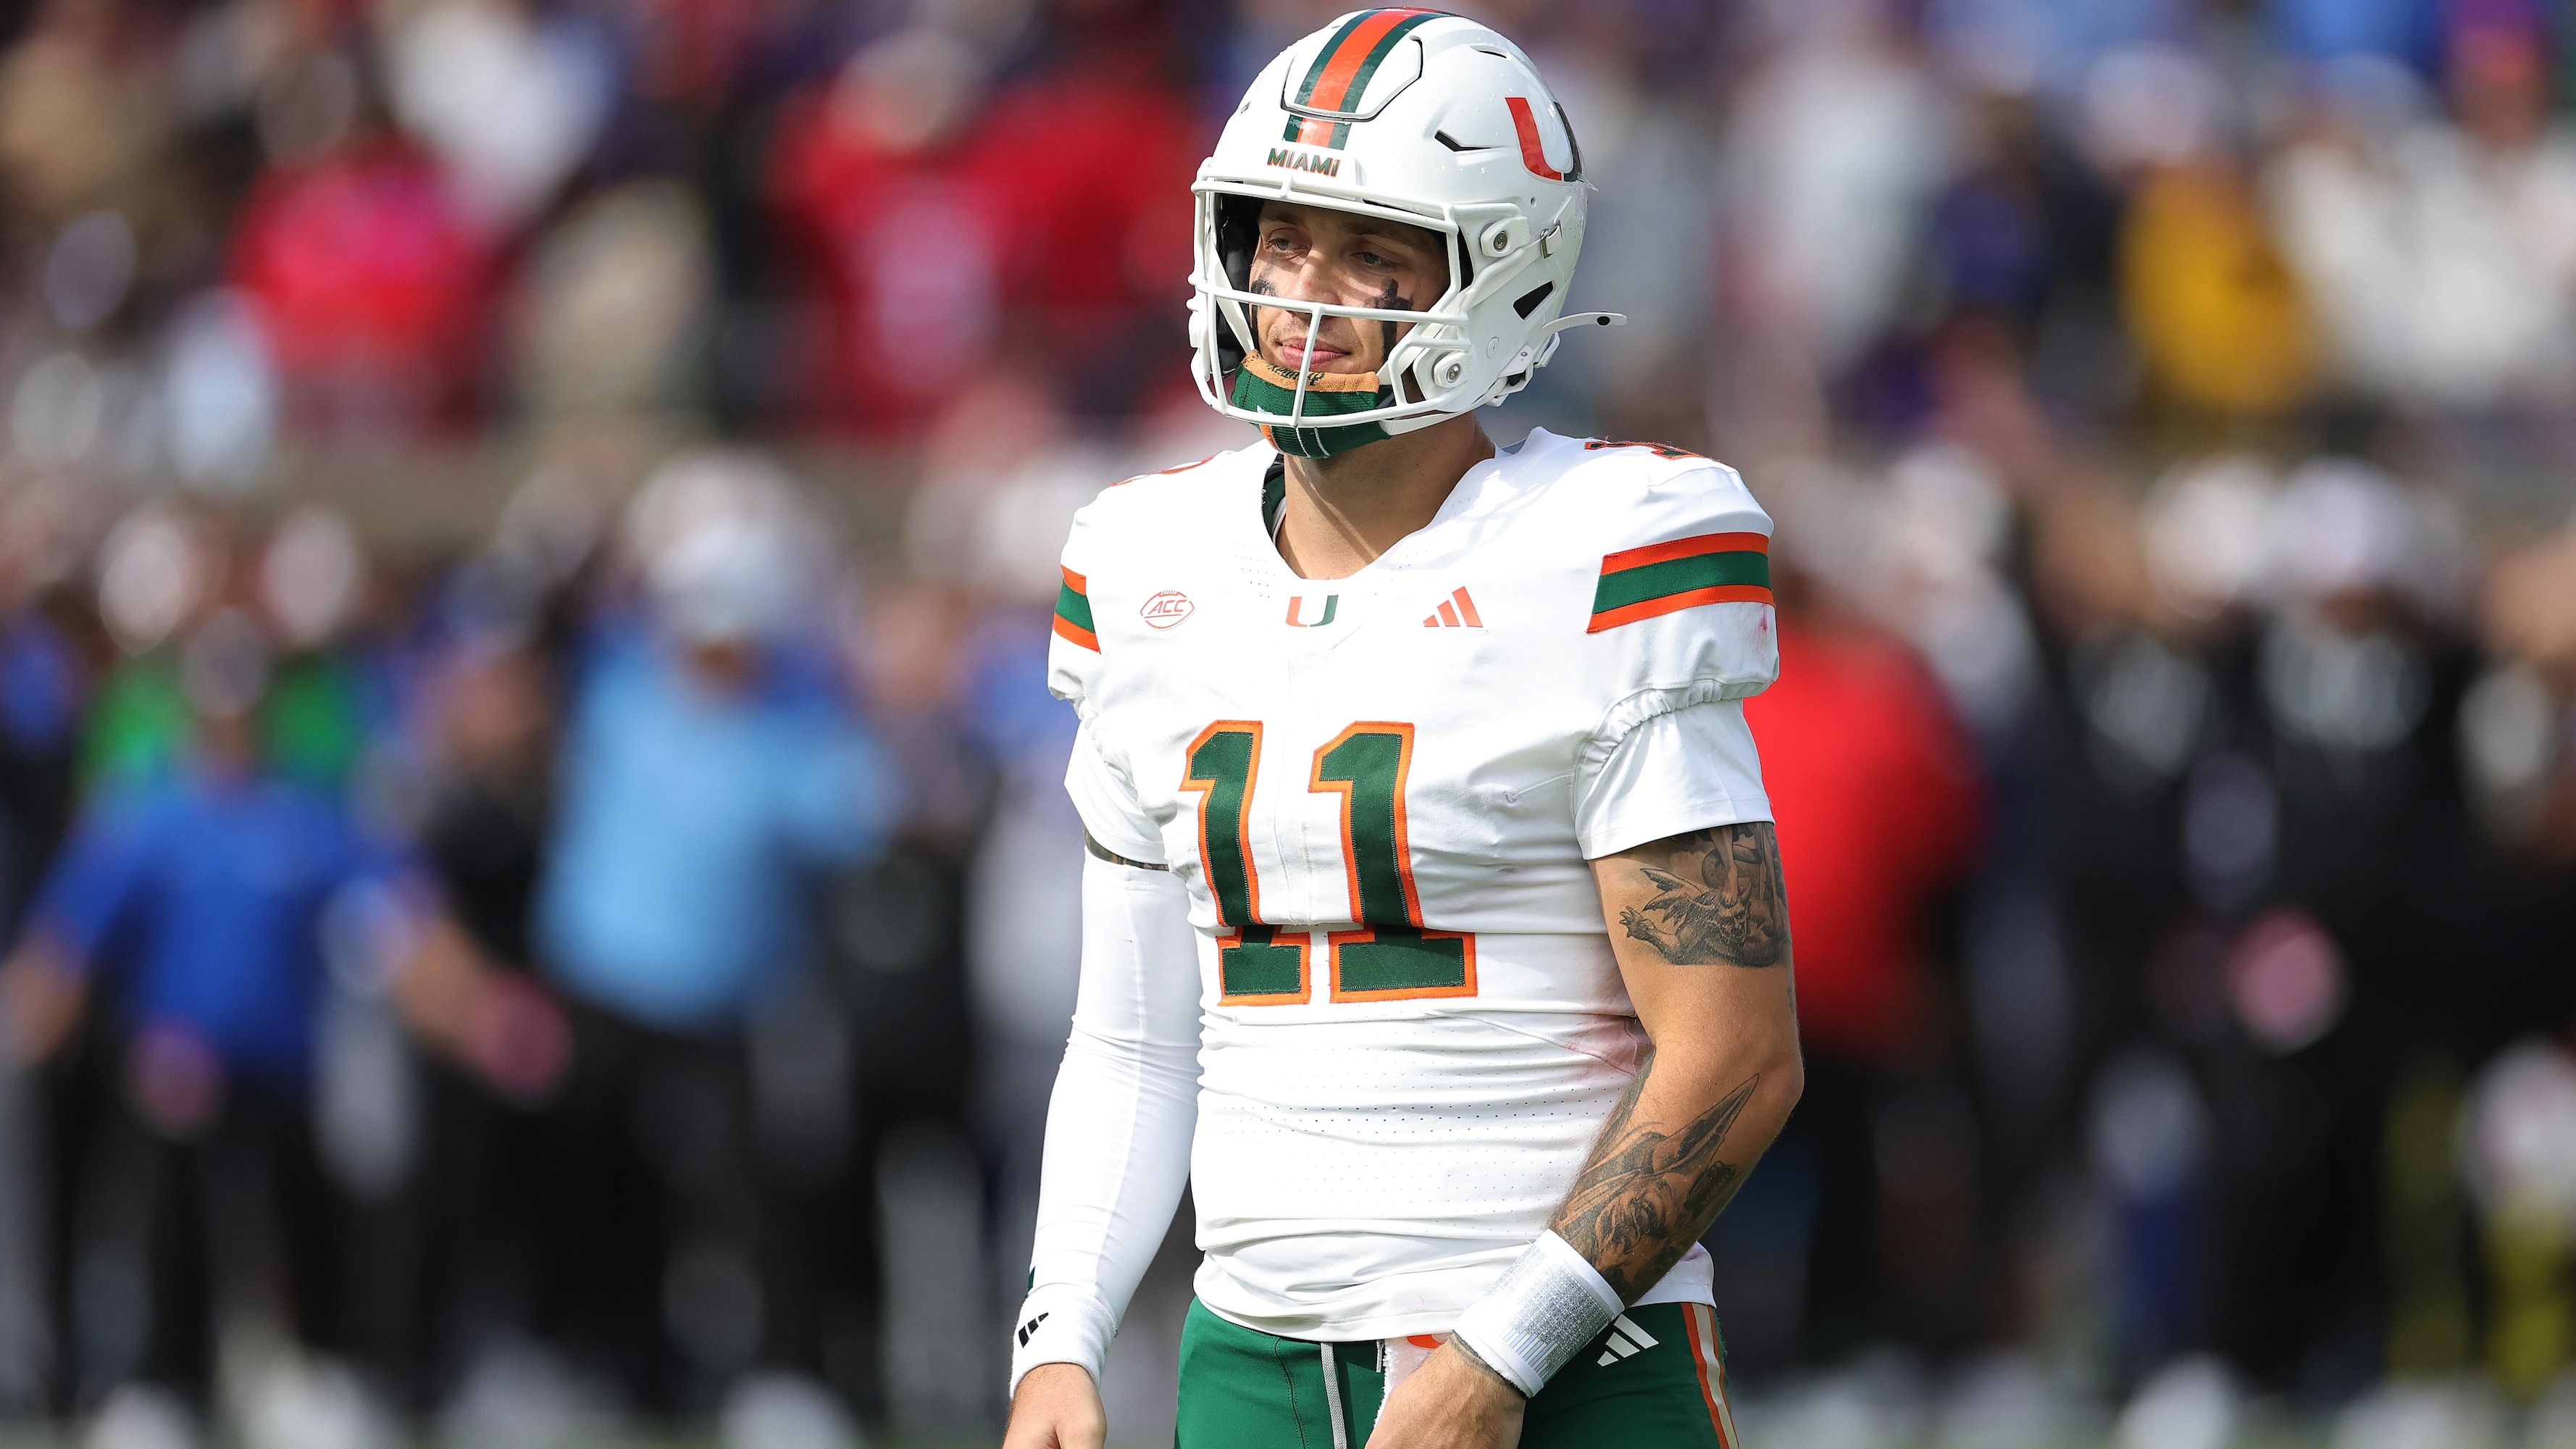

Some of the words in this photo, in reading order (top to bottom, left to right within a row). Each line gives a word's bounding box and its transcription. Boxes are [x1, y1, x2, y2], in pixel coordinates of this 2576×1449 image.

[1505, 96, 1582, 182] U
[1267, 147, 1341, 178] MIAMI
[1147, 599, 1187, 614] ACC
[1285, 595, 1339, 627] U
[1178, 719, 1478, 1007] 11
